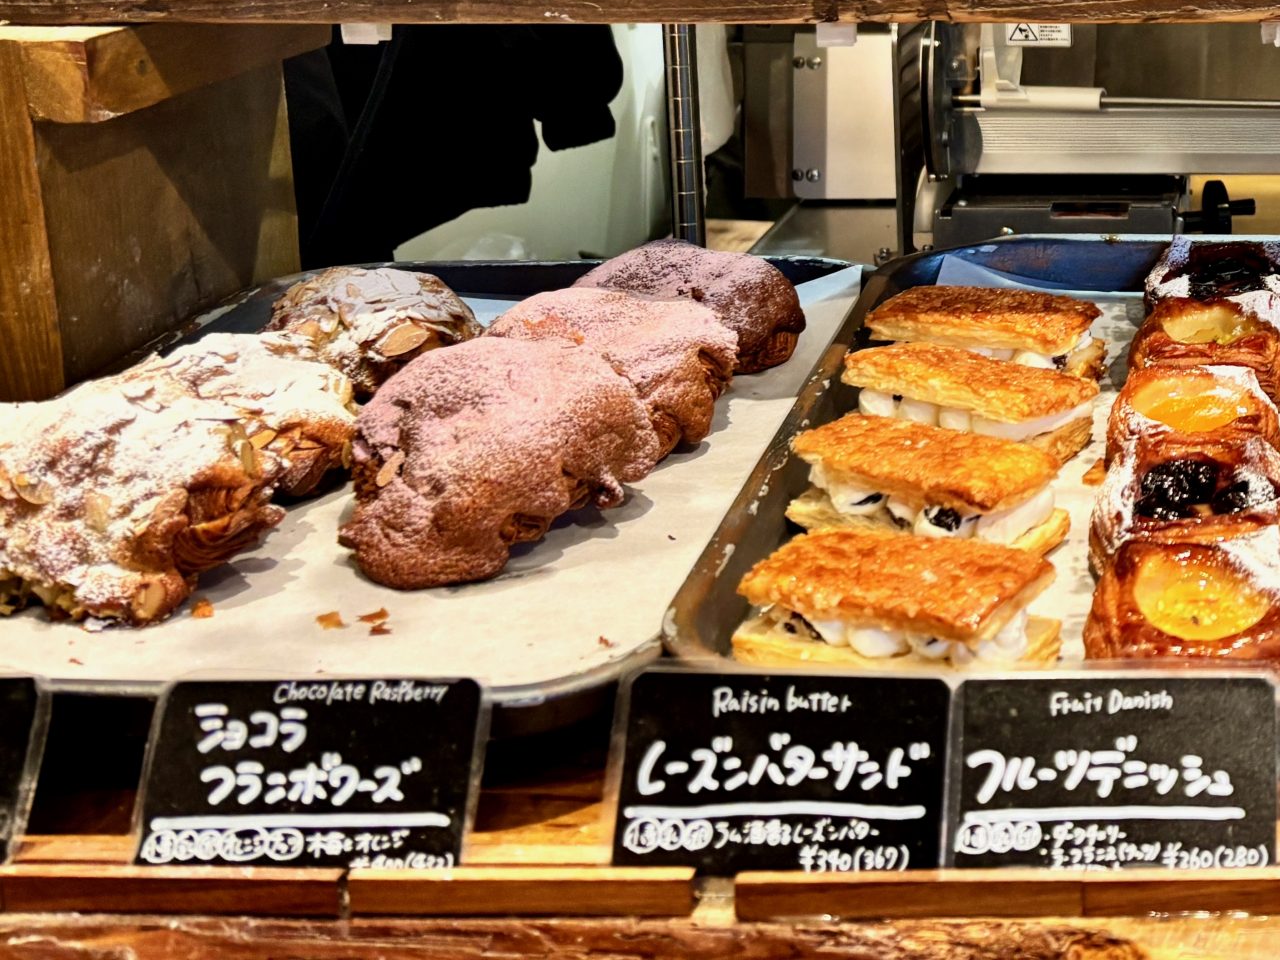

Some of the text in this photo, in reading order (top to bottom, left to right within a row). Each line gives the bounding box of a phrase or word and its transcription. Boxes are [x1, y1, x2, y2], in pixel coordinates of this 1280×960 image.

[273, 681, 366, 705] Chocolate
[712, 685, 853, 717] Raisin butter
[1107, 688, 1174, 715] Danish
[194, 703, 308, 753] ショコラ
[200, 751, 423, 806] フランボワーズ
[636, 731, 932, 796] レーズンバターサンド
[965, 734, 1235, 805] フルーツデニッシュ
